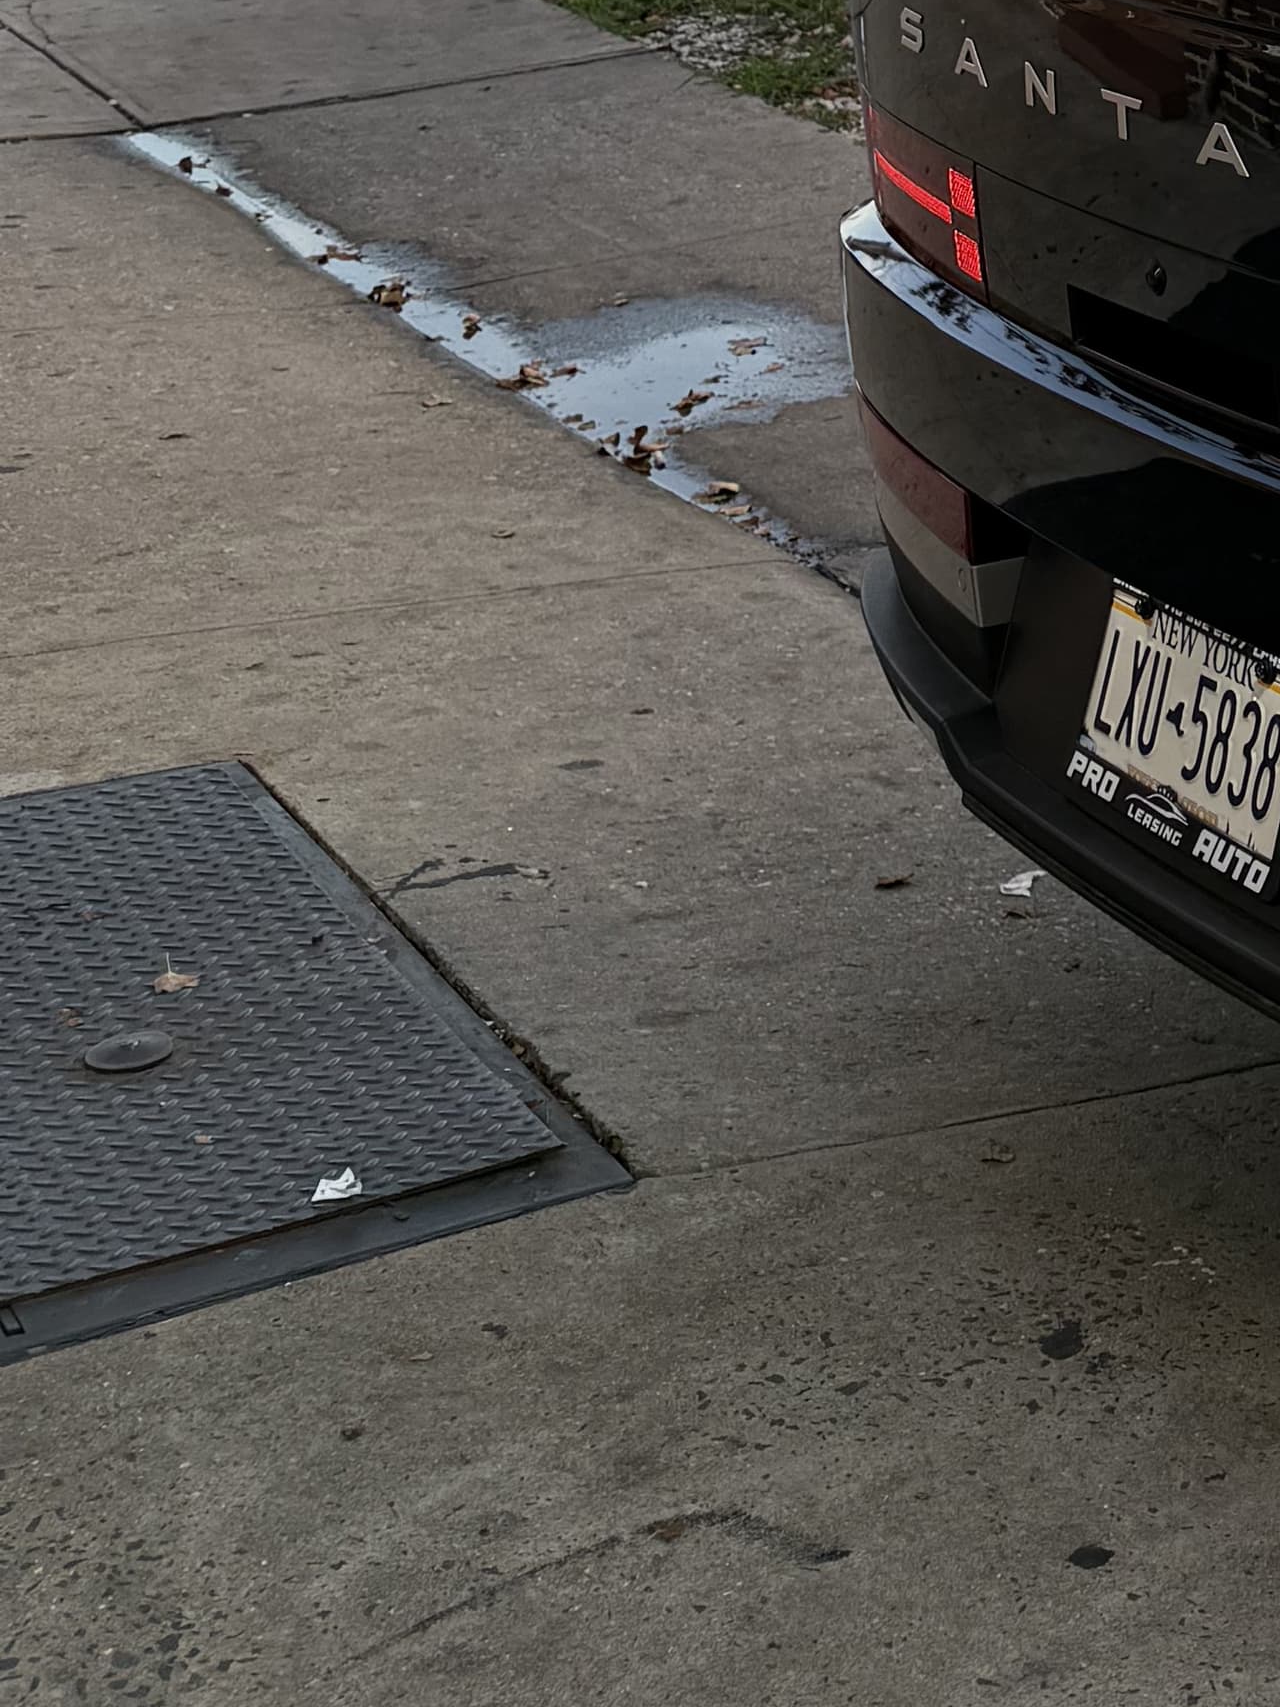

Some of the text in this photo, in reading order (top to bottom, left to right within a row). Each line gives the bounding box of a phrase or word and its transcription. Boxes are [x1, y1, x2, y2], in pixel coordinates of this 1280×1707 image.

[899, 6, 1251, 179] SANTA
[1152, 609, 1199, 659] NEW
[1203, 633, 1260, 692] YORK
[1094, 628, 1172, 757] LXU
[1066, 750, 1121, 803] PRO
[1126, 802, 1183, 847] LEASING
[1191, 828, 1271, 894] AUTO
